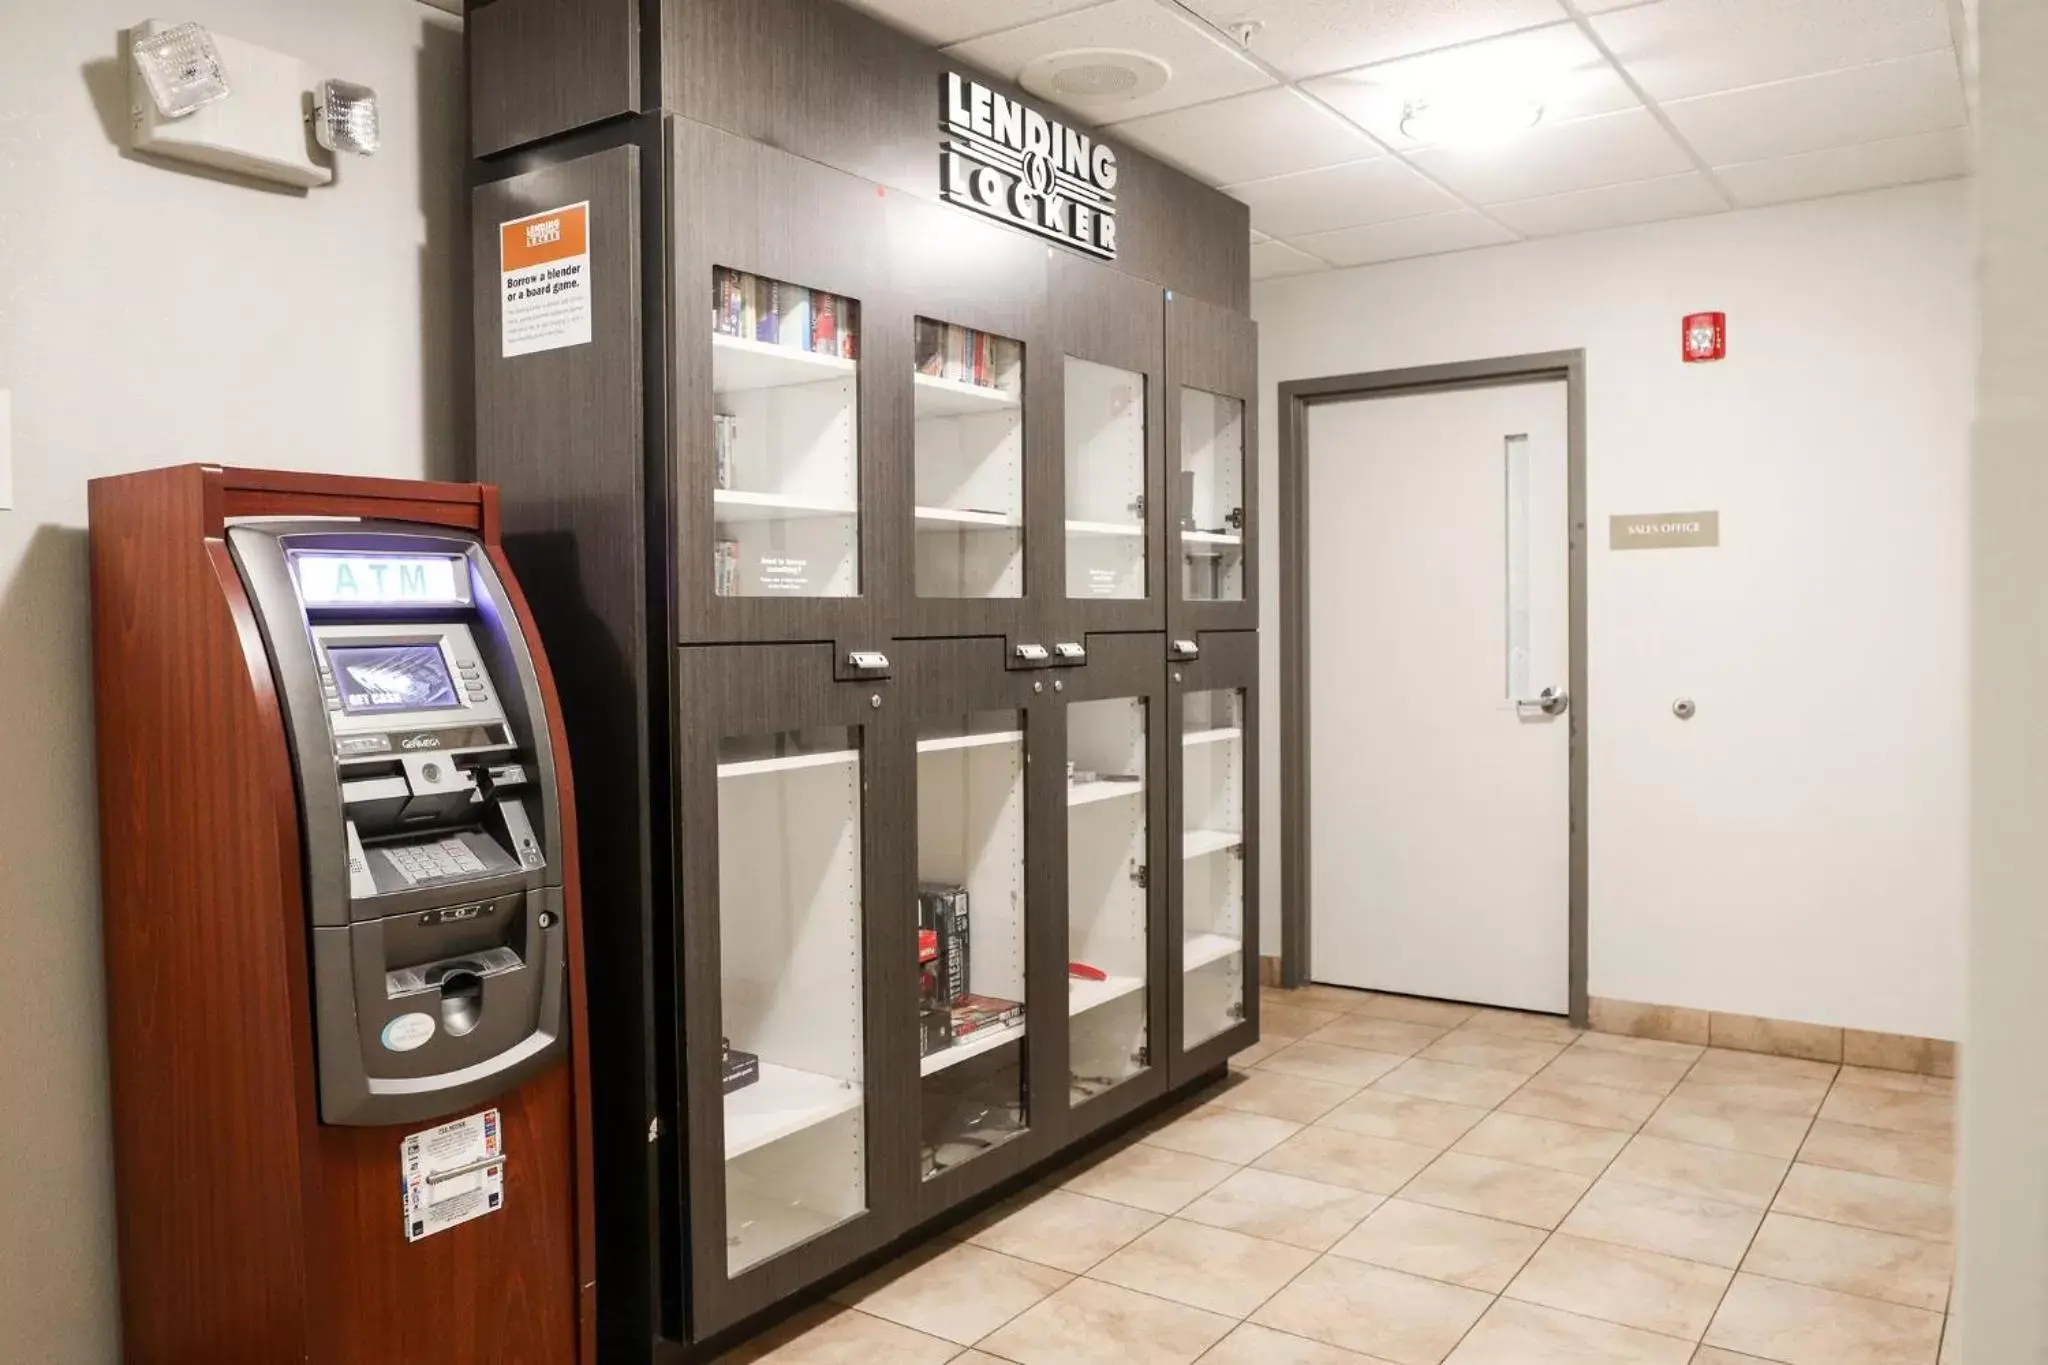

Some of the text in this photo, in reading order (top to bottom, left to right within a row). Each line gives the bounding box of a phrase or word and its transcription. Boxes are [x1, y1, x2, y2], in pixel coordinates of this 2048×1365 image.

[947, 71, 1117, 190] LENDING
[947, 151, 1117, 251] LOCKER
[507, 264, 581, 289] Borrow a blender
[507, 279, 580, 302] or a board game.
[1627, 522, 1700, 535] SALES OFFICE
[336, 562, 427, 596] ATM
[947, 934, 962, 1001] TTLESHIP
